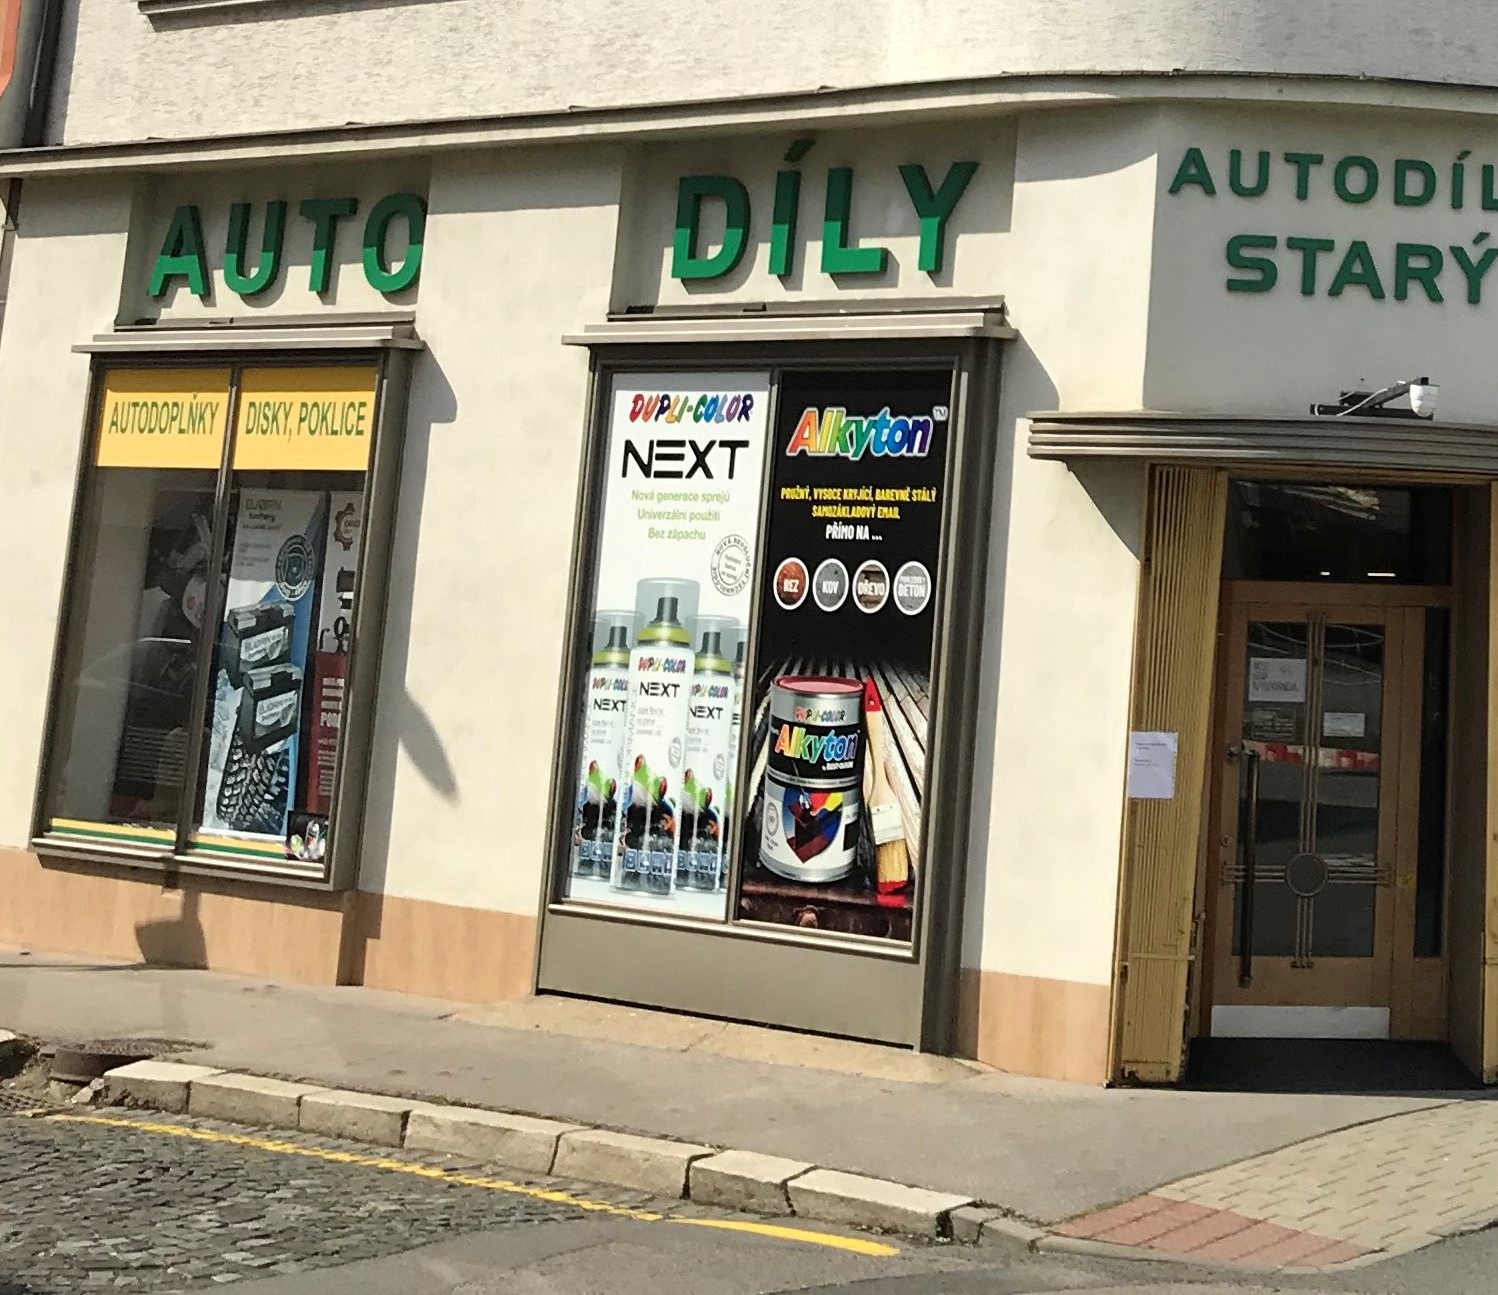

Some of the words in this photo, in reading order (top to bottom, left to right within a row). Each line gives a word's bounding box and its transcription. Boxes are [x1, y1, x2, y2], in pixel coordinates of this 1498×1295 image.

[671, 139, 980, 280] DÍLY
[147, 192, 428, 298] AUTO
[109, 393, 220, 436] AUTODOPLŇKY
[629, 393, 754, 424] DUPLI-COLOR
[245, 400, 293, 443] DISKY,
[298, 400, 367, 438] POKLICE
[786, 406, 934, 461] Alkyton
[621, 438, 750, 480] NEXT
[631, 489, 654, 501] Nová
[656, 492, 698, 503] generace
[637, 508, 687, 521] Univerzální
[689, 509, 720, 523] použití
[648, 527, 665, 539] Bez
[667, 528, 706, 541] zápachu
[825, 521, 854, 540] PŘÍMO
[856, 525, 870, 540] NA
[783, 578, 800, 593] REZ
[821, 580, 839, 594] KOV
[857, 579, 885, 596] DŘEVO
[898, 584, 926, 598] BETON
[639, 681, 680, 698] NEXT
[593, 698, 627, 713] NEXT
[774, 723, 859, 764] Alkyton
